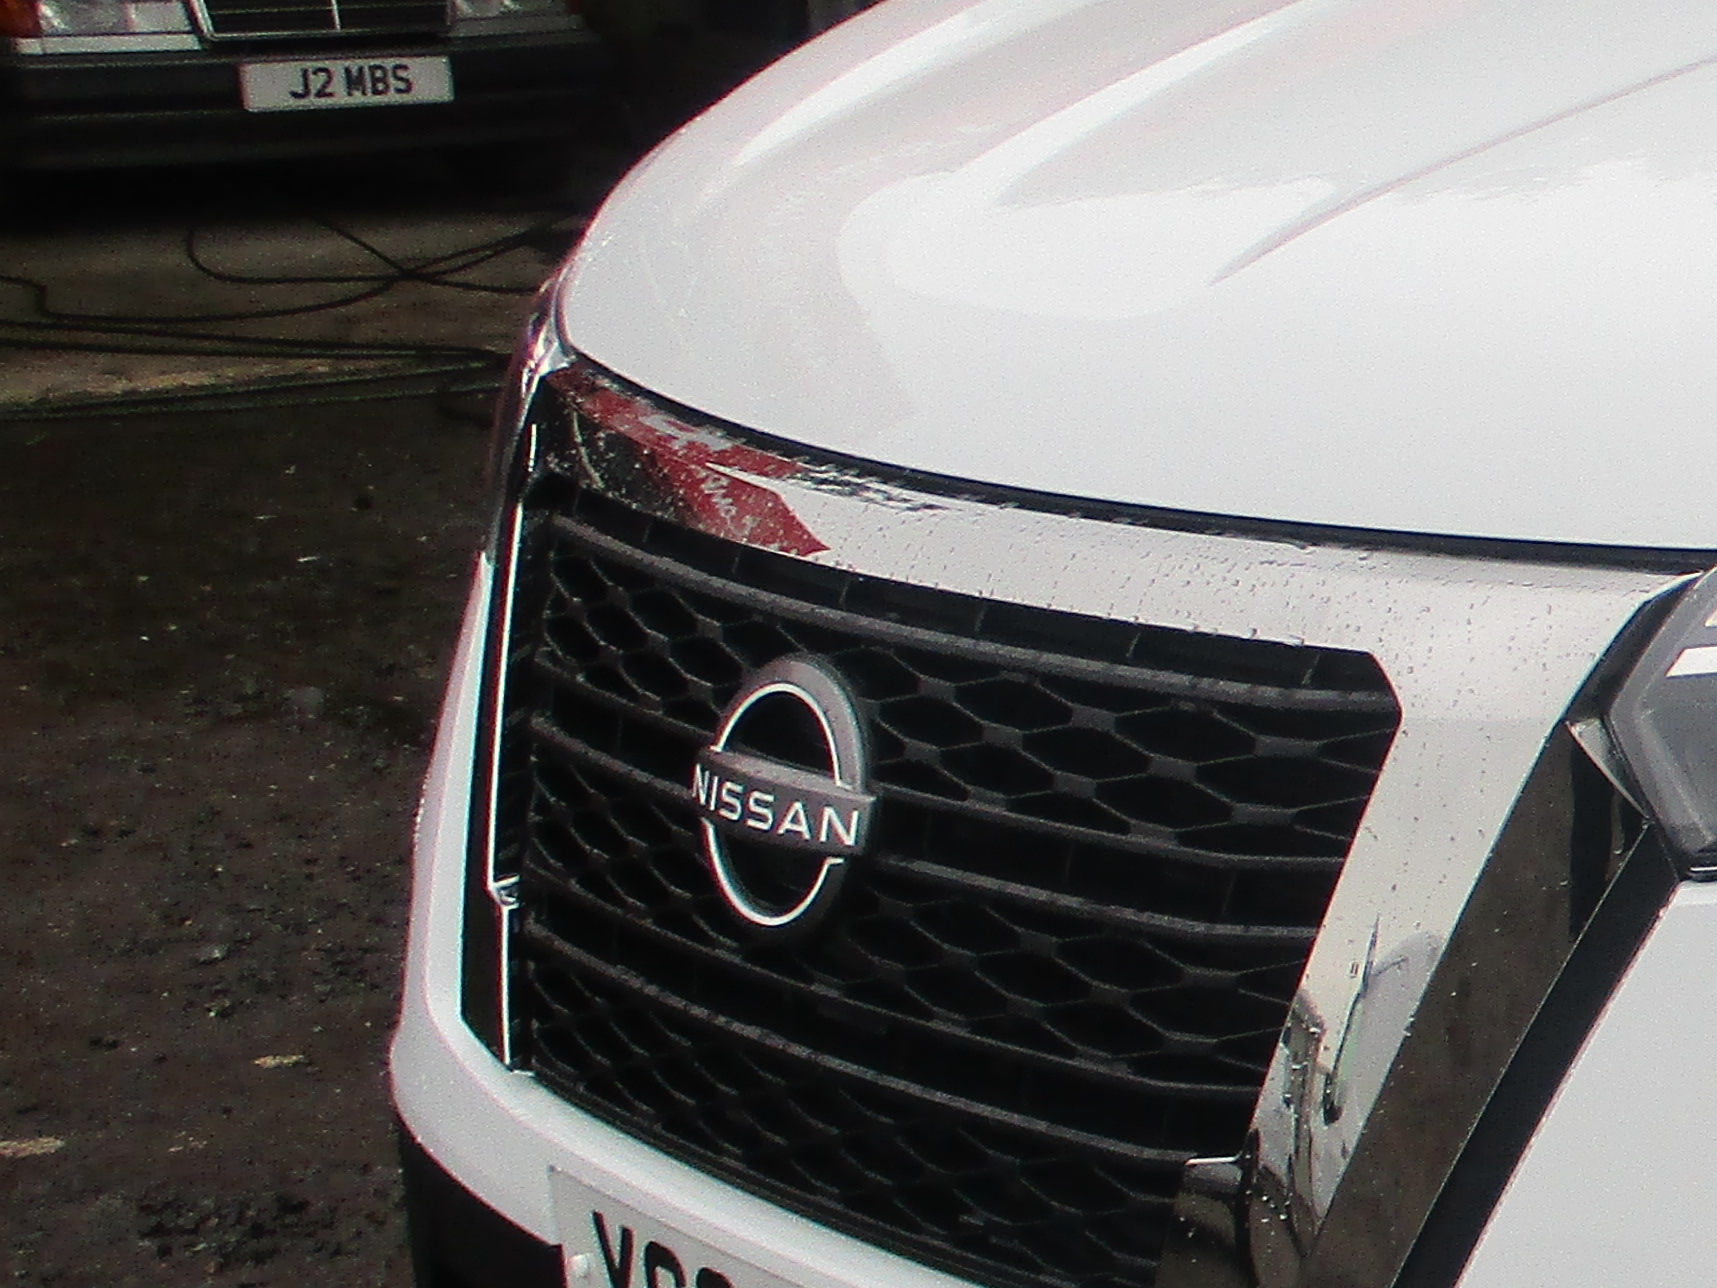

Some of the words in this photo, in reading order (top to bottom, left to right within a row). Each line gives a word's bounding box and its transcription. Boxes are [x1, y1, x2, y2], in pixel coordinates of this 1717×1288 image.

[289, 66, 335, 100] J2
[344, 63, 414, 97] MBS
[691, 762, 861, 848] NISSAN
